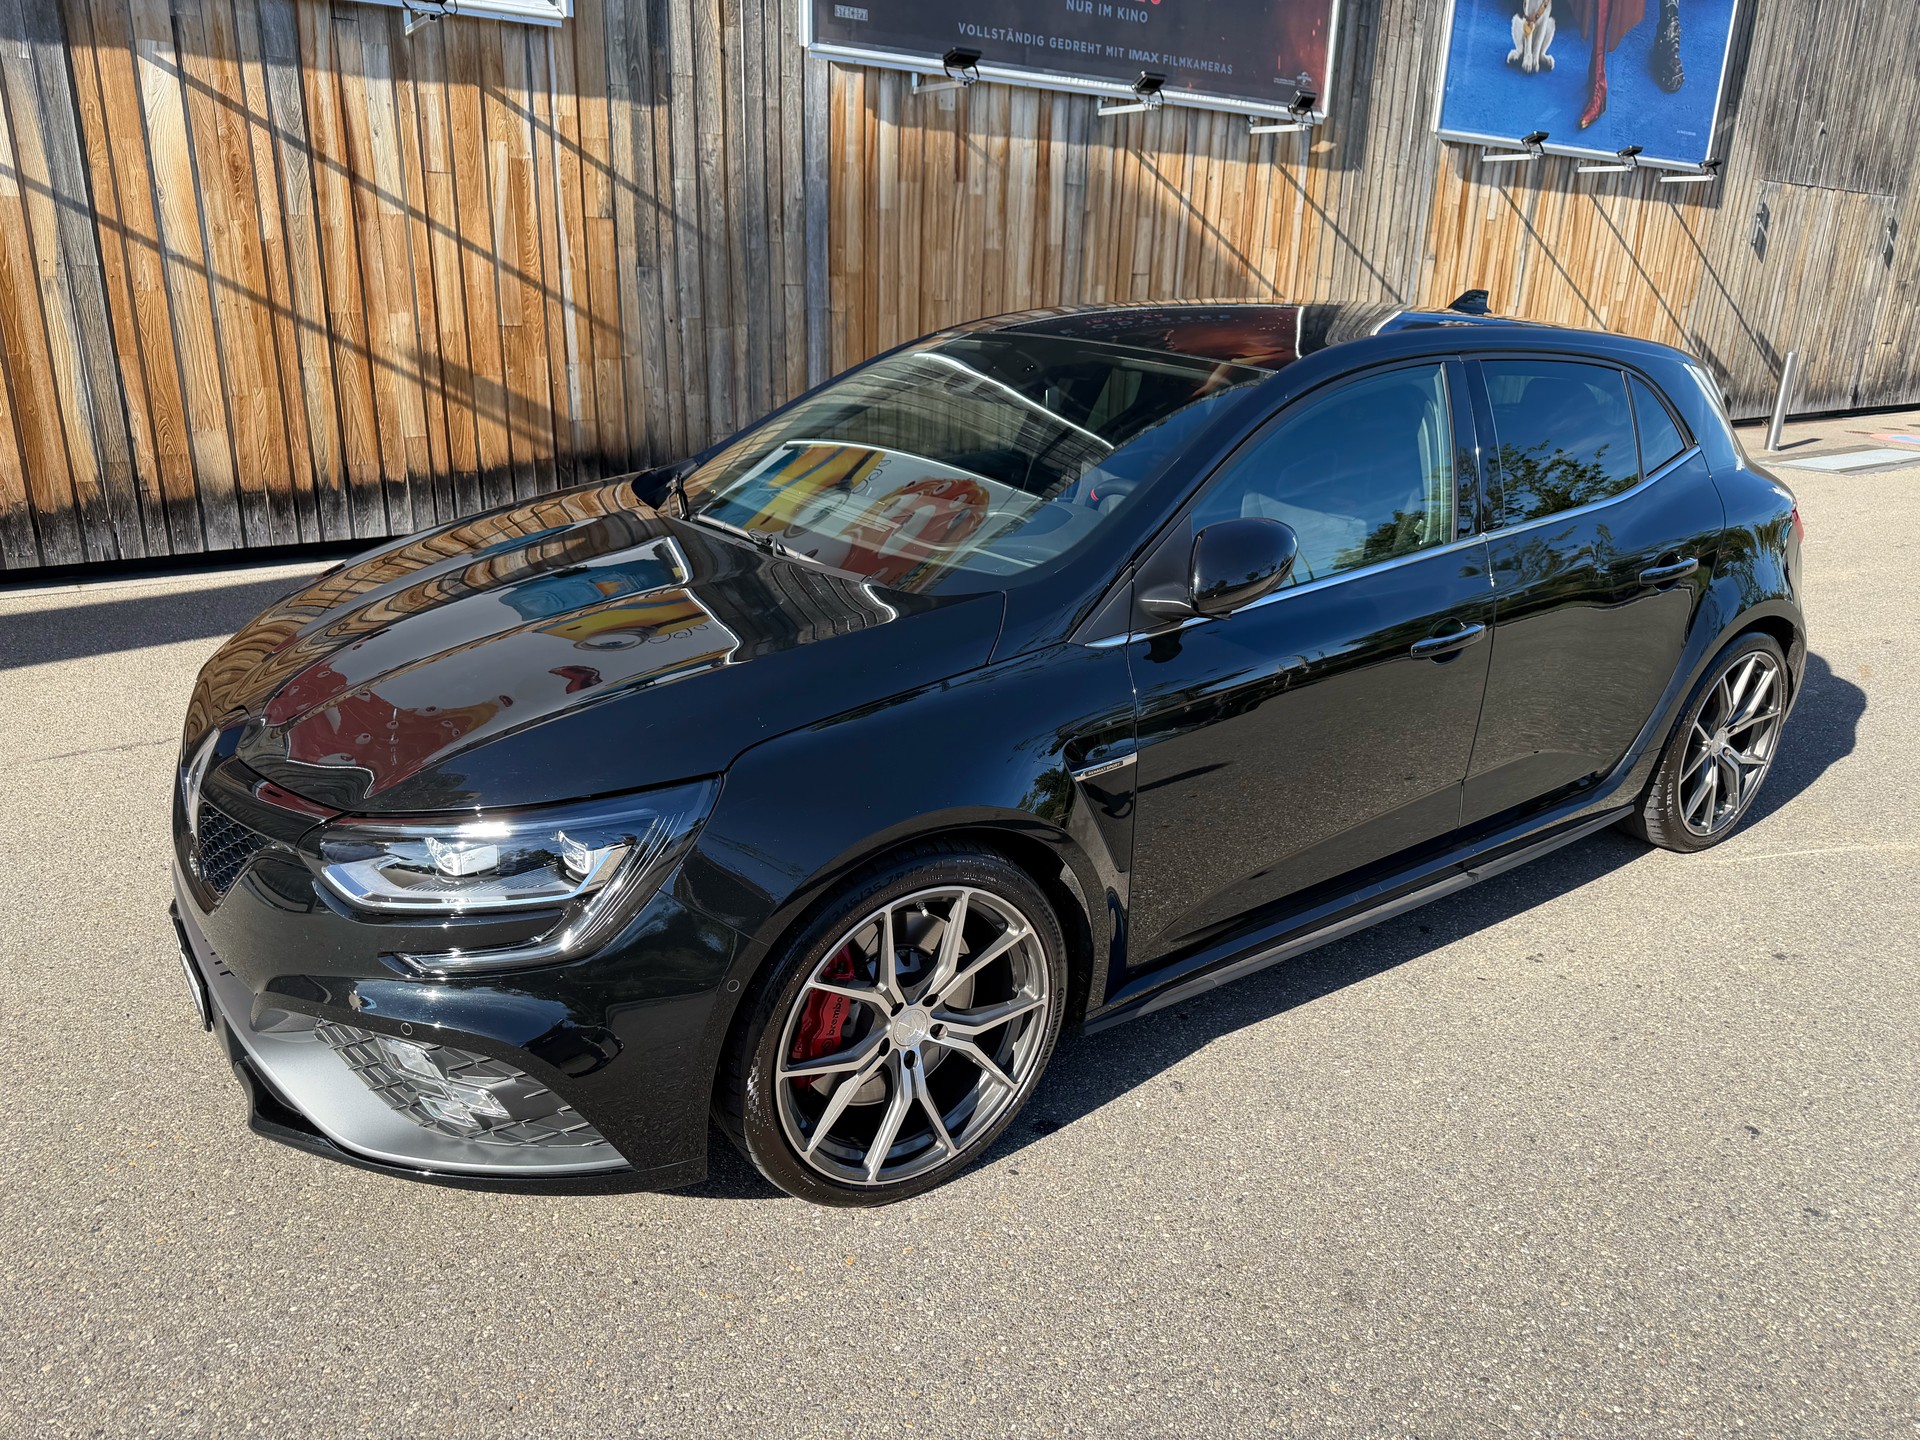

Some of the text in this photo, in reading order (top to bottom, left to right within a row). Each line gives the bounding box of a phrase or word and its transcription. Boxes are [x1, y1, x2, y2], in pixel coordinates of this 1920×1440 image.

[1066, 0, 1148, 23] NUR IM KINO
[958, 22, 1233, 75] VOLLSTÄNDIG GEDREHT MIT IMAX FILMKAMERAS
[826, 996, 843, 1037] brembo
[1042, 986, 1065, 1060] Continental
